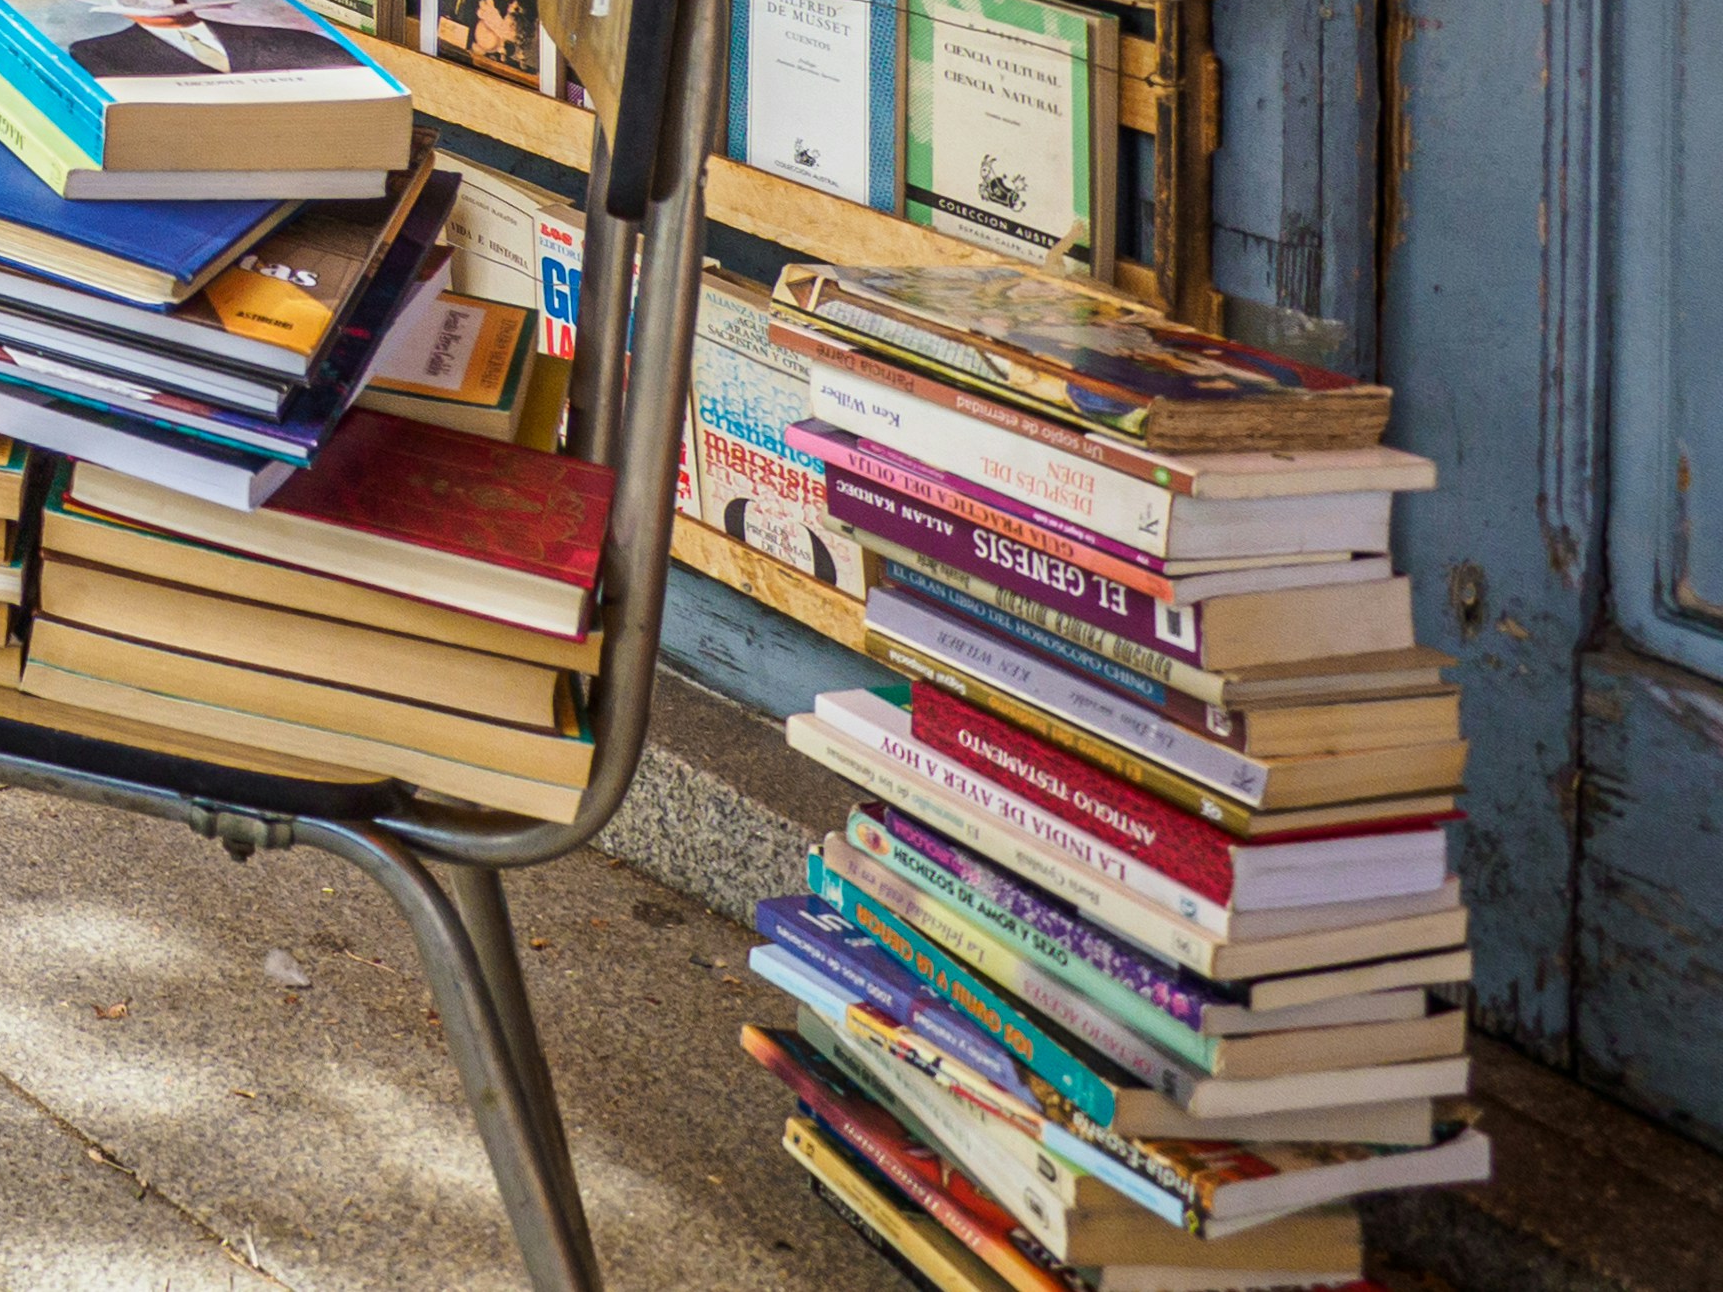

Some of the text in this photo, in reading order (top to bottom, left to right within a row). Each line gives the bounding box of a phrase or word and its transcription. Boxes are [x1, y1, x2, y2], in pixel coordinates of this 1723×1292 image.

[767, 2, 852, 39] DE MUSSET
[784, 29, 832, 53] CUENTOS
[943, 39, 1064, 90] CIENCIA CULTURAL
[943, 67, 1064, 118] CIENCIA NATURAL
[820, 382, 902, 429] Ken Wilber
[980, 456, 1094, 516] DESPUÉS DEL
[1047, 460, 1096, 493] EDÉN
[835, 478, 954, 537] ALLAN KARDEC
[973, 528, 1129, 617] EL GENESIS
[936, 630, 1032, 684] KEN WILBER
[879, 734, 921, 771] HOY
[939, 765, 995, 813] AYER
[957, 728, 1157, 846] ANTIGUO TESTAMENTO
[998, 798, 1025, 826] DE
[1031, 813, 1096, 864] INDIA
[1099, 857, 1127, 882] LA
